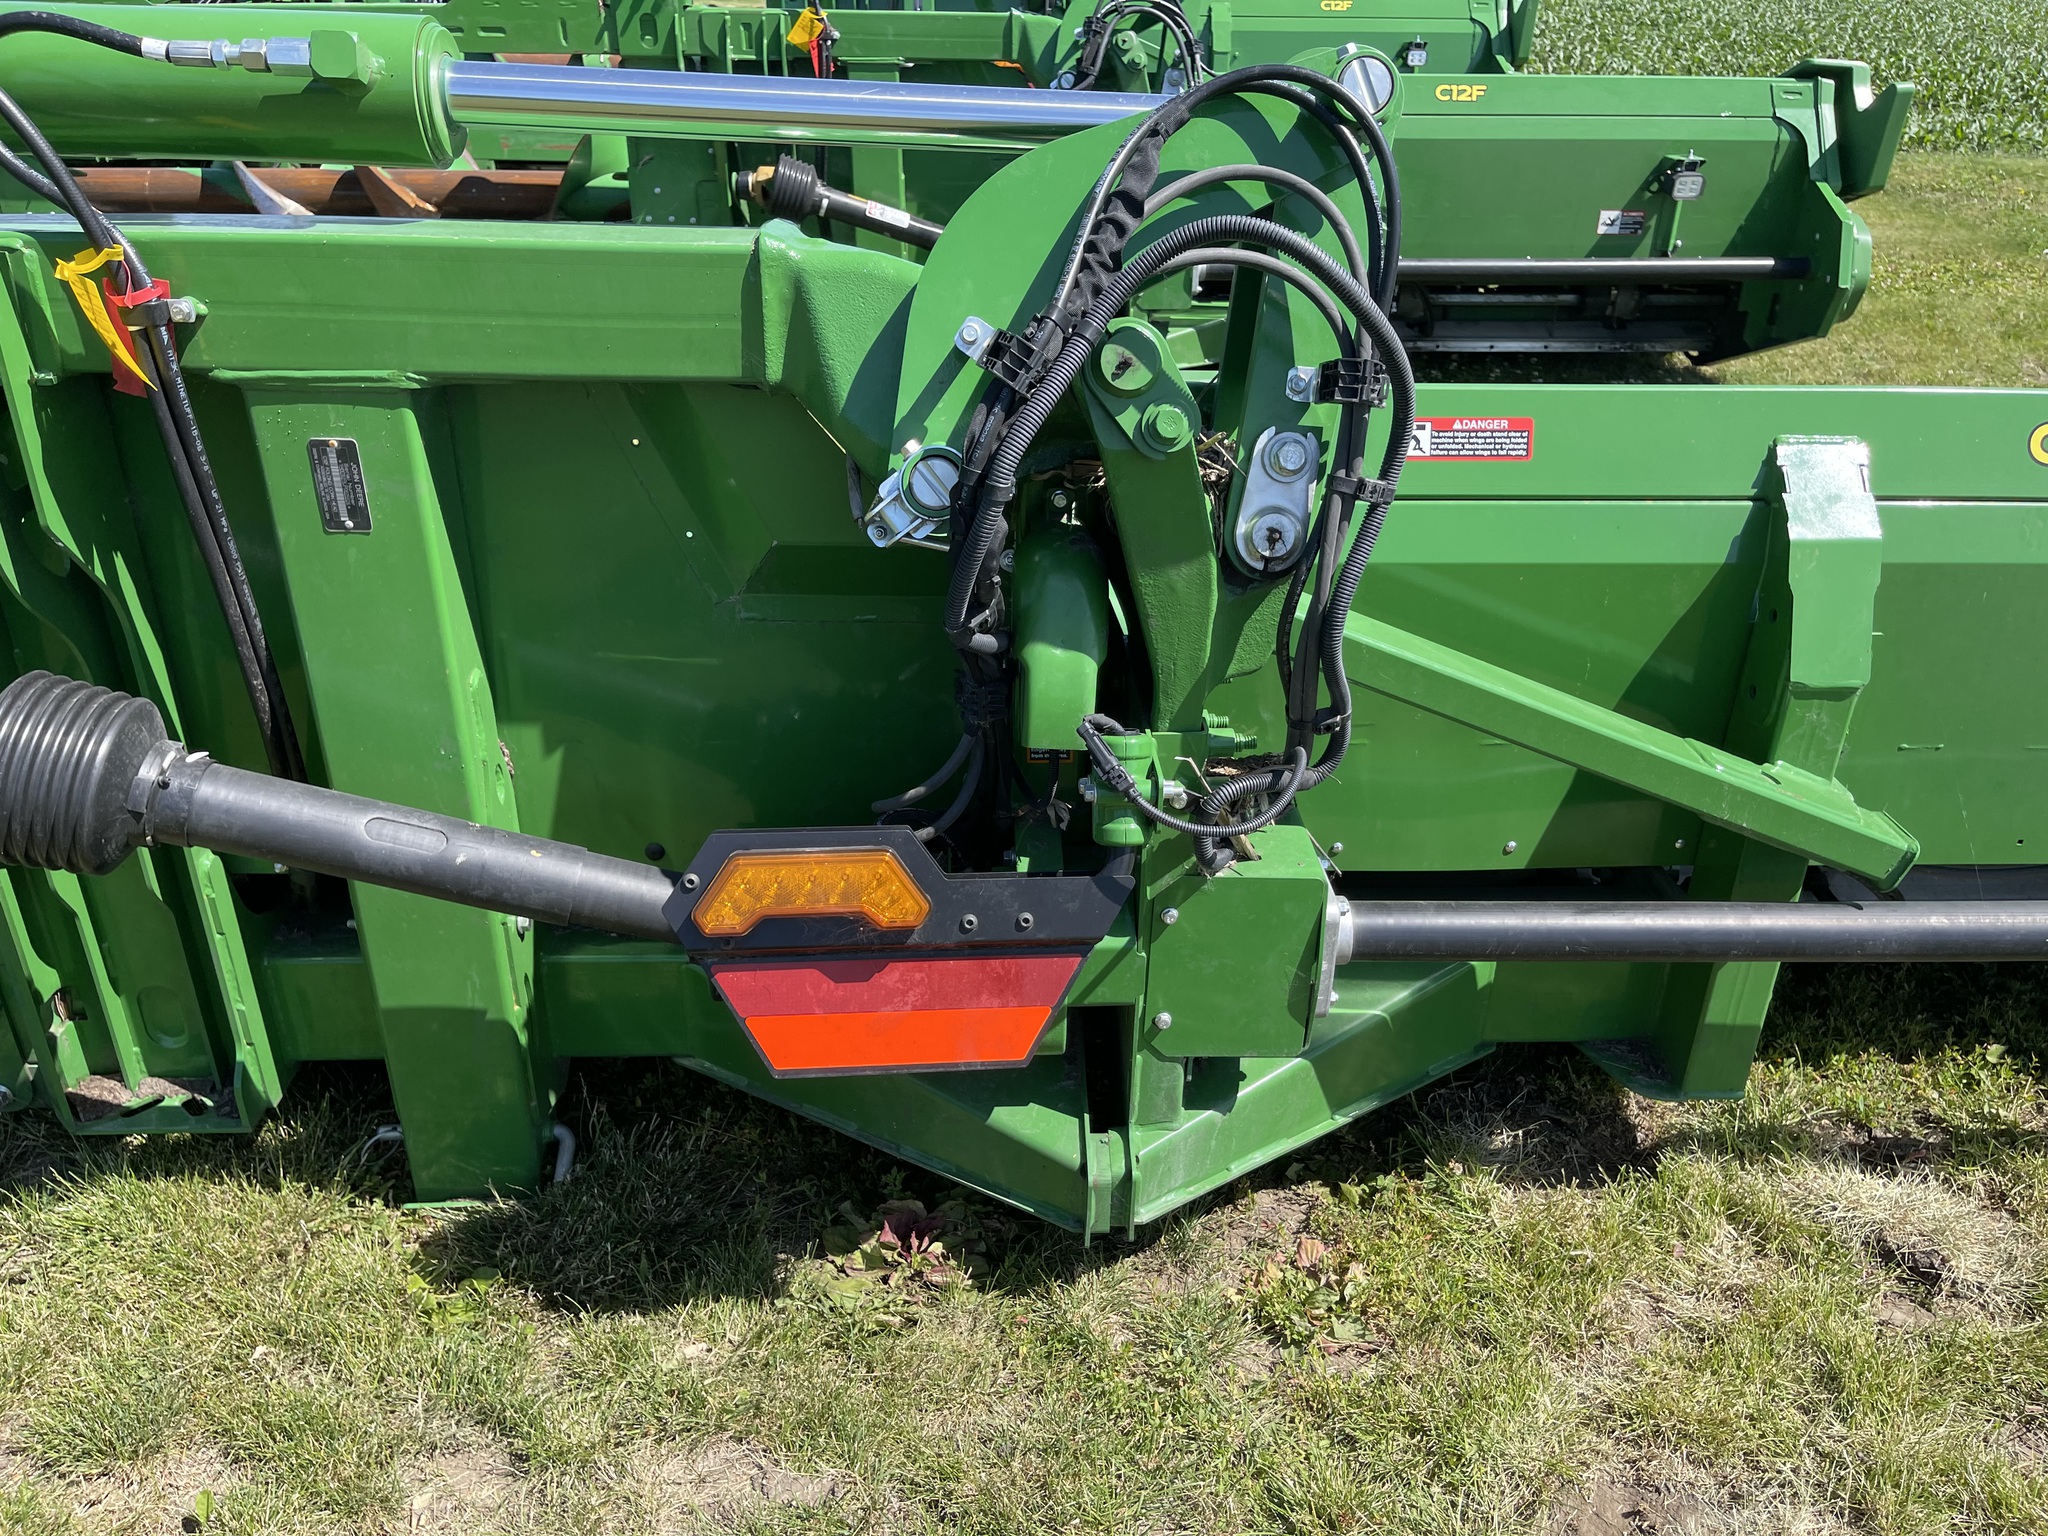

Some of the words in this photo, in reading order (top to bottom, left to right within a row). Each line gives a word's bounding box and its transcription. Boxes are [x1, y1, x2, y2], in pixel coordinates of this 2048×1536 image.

[1320, 0, 1353, 11] C12F
[1435, 84, 1487, 102] C12F
[1463, 420, 1508, 429] DANGER
[351, 462, 360, 482] JOHN
[355, 485, 364, 507] DEERE
